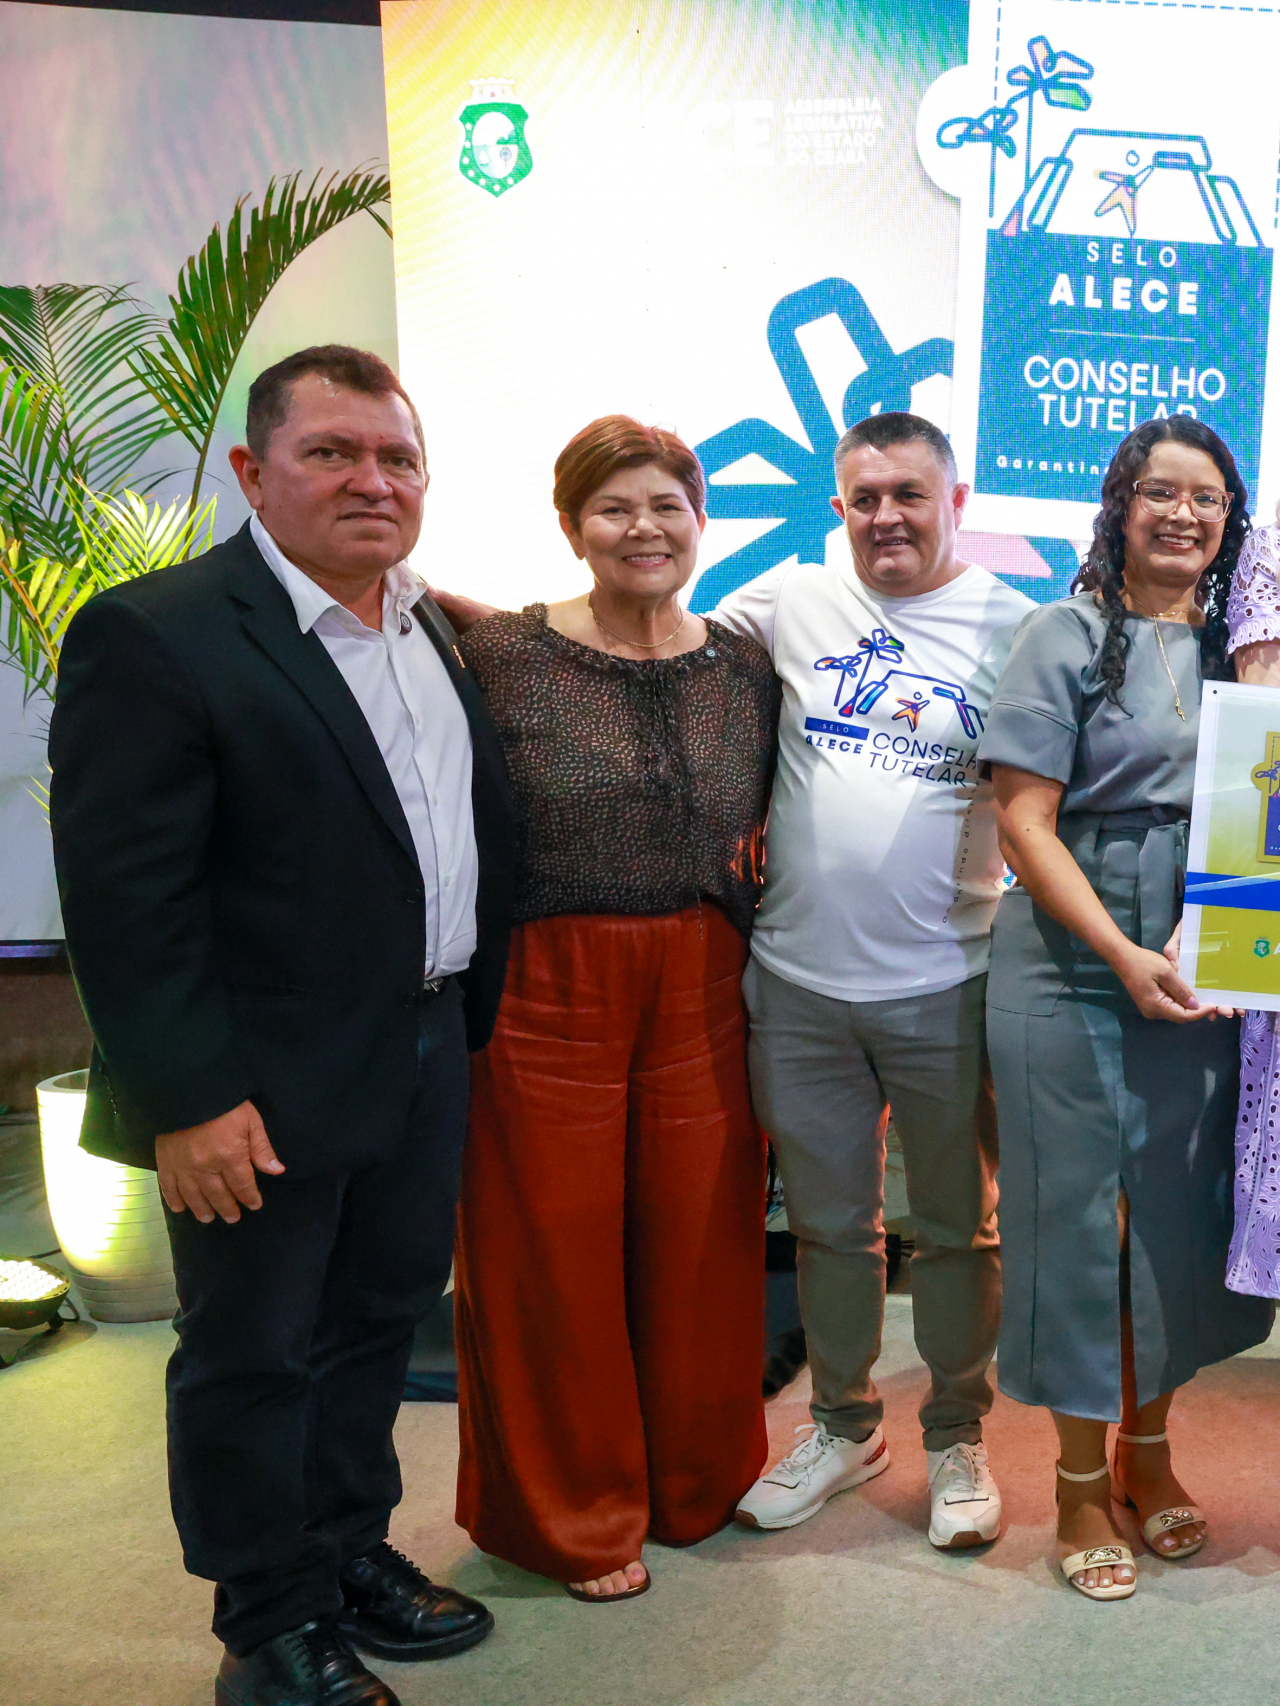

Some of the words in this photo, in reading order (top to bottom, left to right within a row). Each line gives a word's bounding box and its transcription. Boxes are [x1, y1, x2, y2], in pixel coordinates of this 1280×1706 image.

[785, 115, 884, 131] LEGISLATIVA
[814, 132, 876, 148] ESTADO
[1086, 242, 1176, 268] SELO
[1049, 273, 1199, 315] ALECE
[1024, 355, 1226, 401] CONSELHO
[822, 723, 849, 733] SELO
[805, 733, 864, 755] ALECE
[872, 732, 977, 771] CONSELH
[869, 751, 966, 788] TUTELAR
